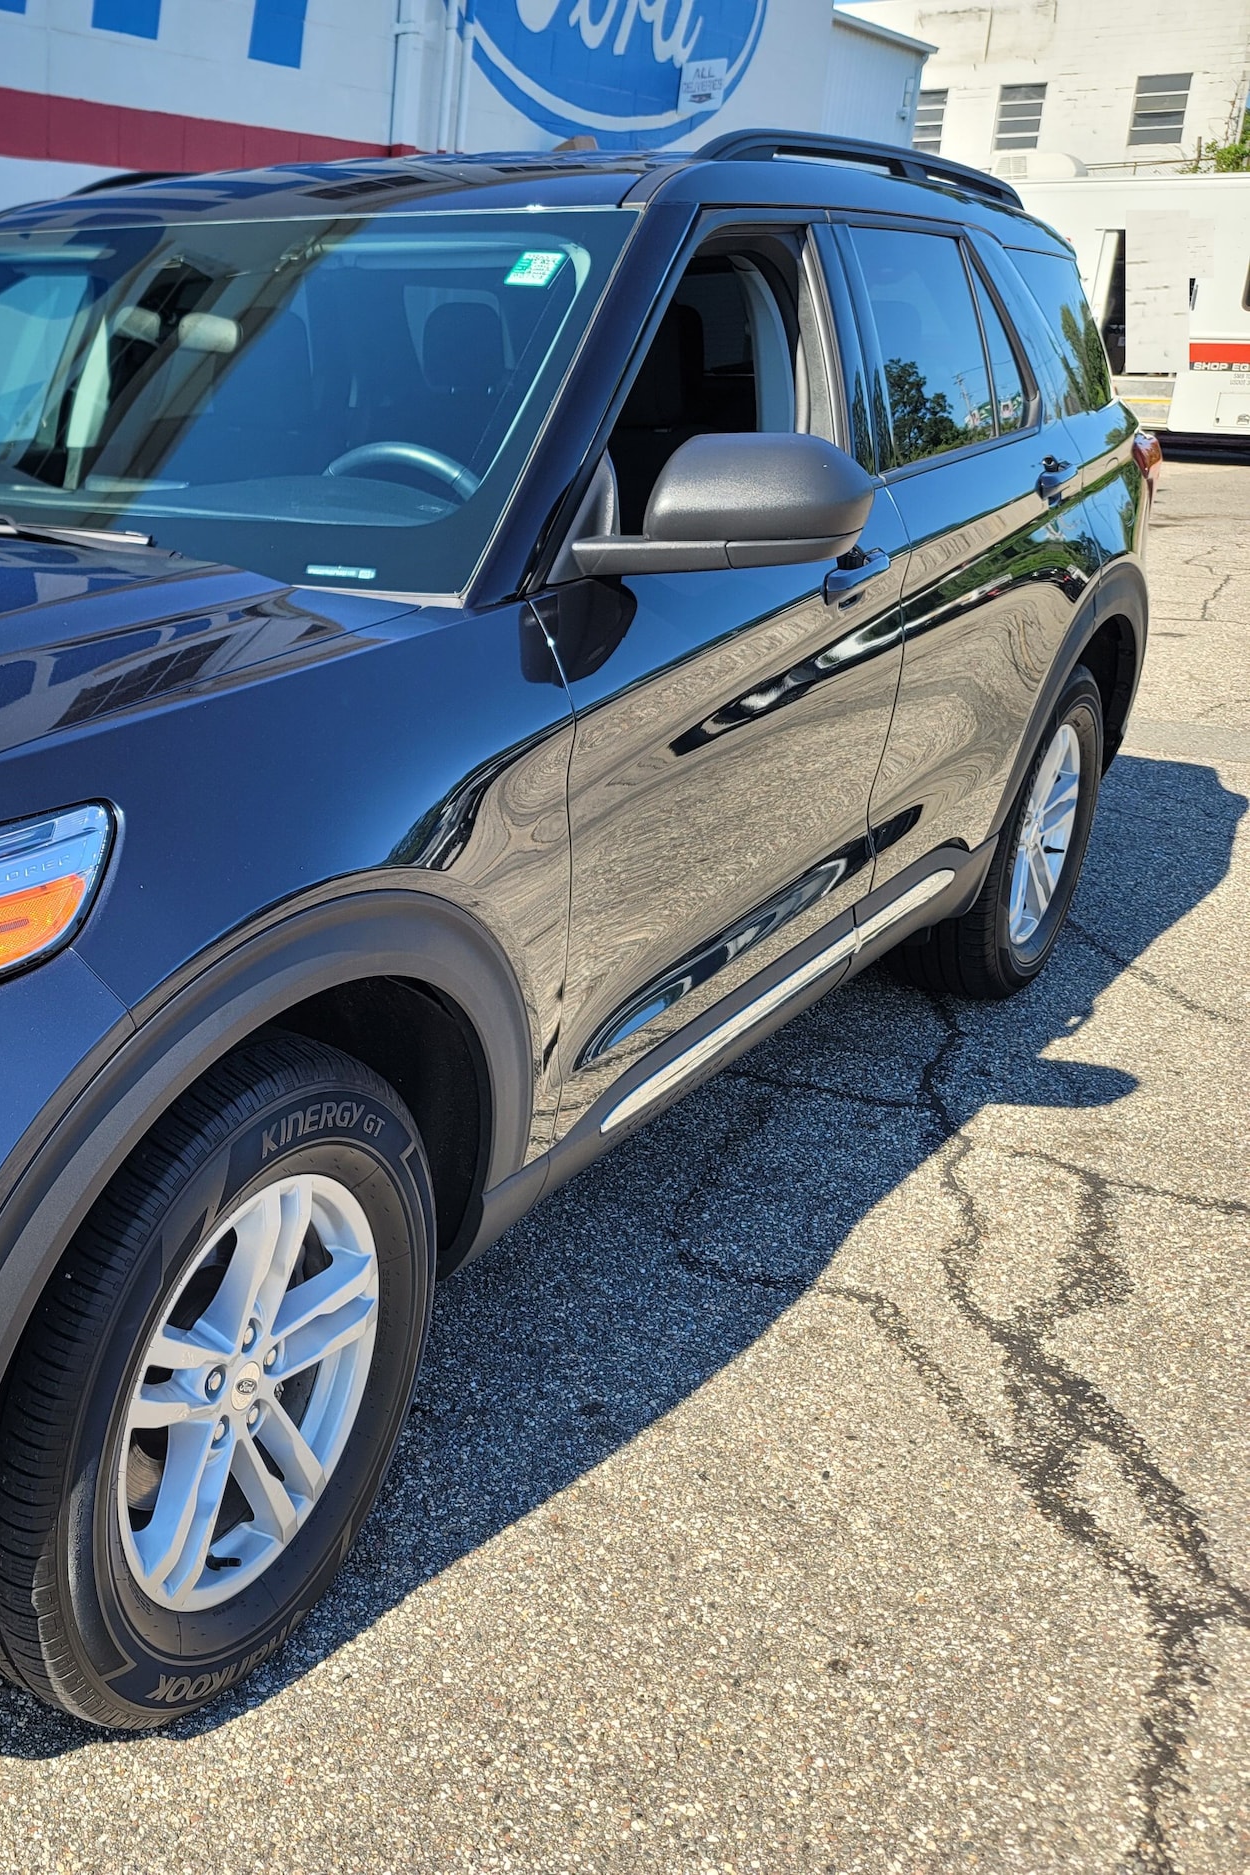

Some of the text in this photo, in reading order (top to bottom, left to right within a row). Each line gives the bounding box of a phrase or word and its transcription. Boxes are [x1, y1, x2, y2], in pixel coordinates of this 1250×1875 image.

[693, 66, 716, 80] ALL
[1193, 362, 1229, 371] SHOP
[262, 1101, 386, 1159] KINERGY GT
